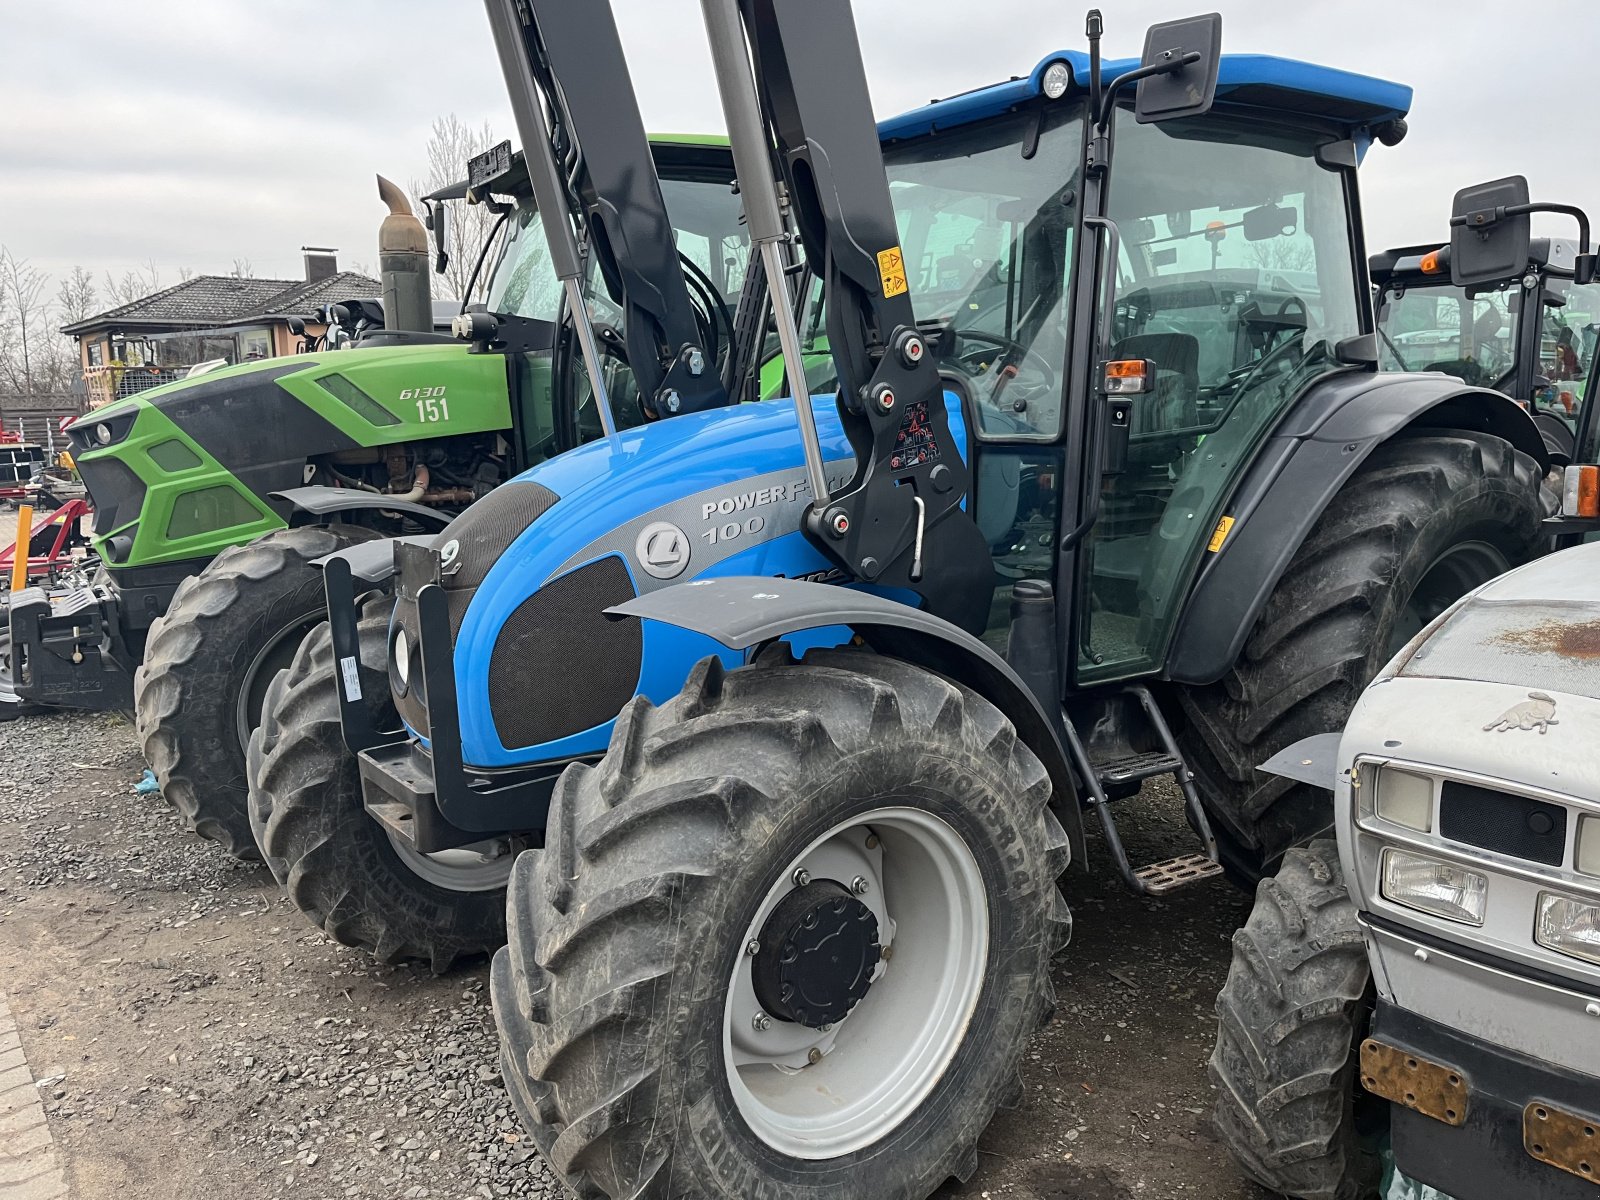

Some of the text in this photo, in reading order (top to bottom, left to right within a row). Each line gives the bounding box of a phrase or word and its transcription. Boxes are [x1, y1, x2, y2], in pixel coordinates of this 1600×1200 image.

[400, 386, 446, 400] 6130
[416, 398, 449, 423] 151
[701, 516, 765, 546] 100
